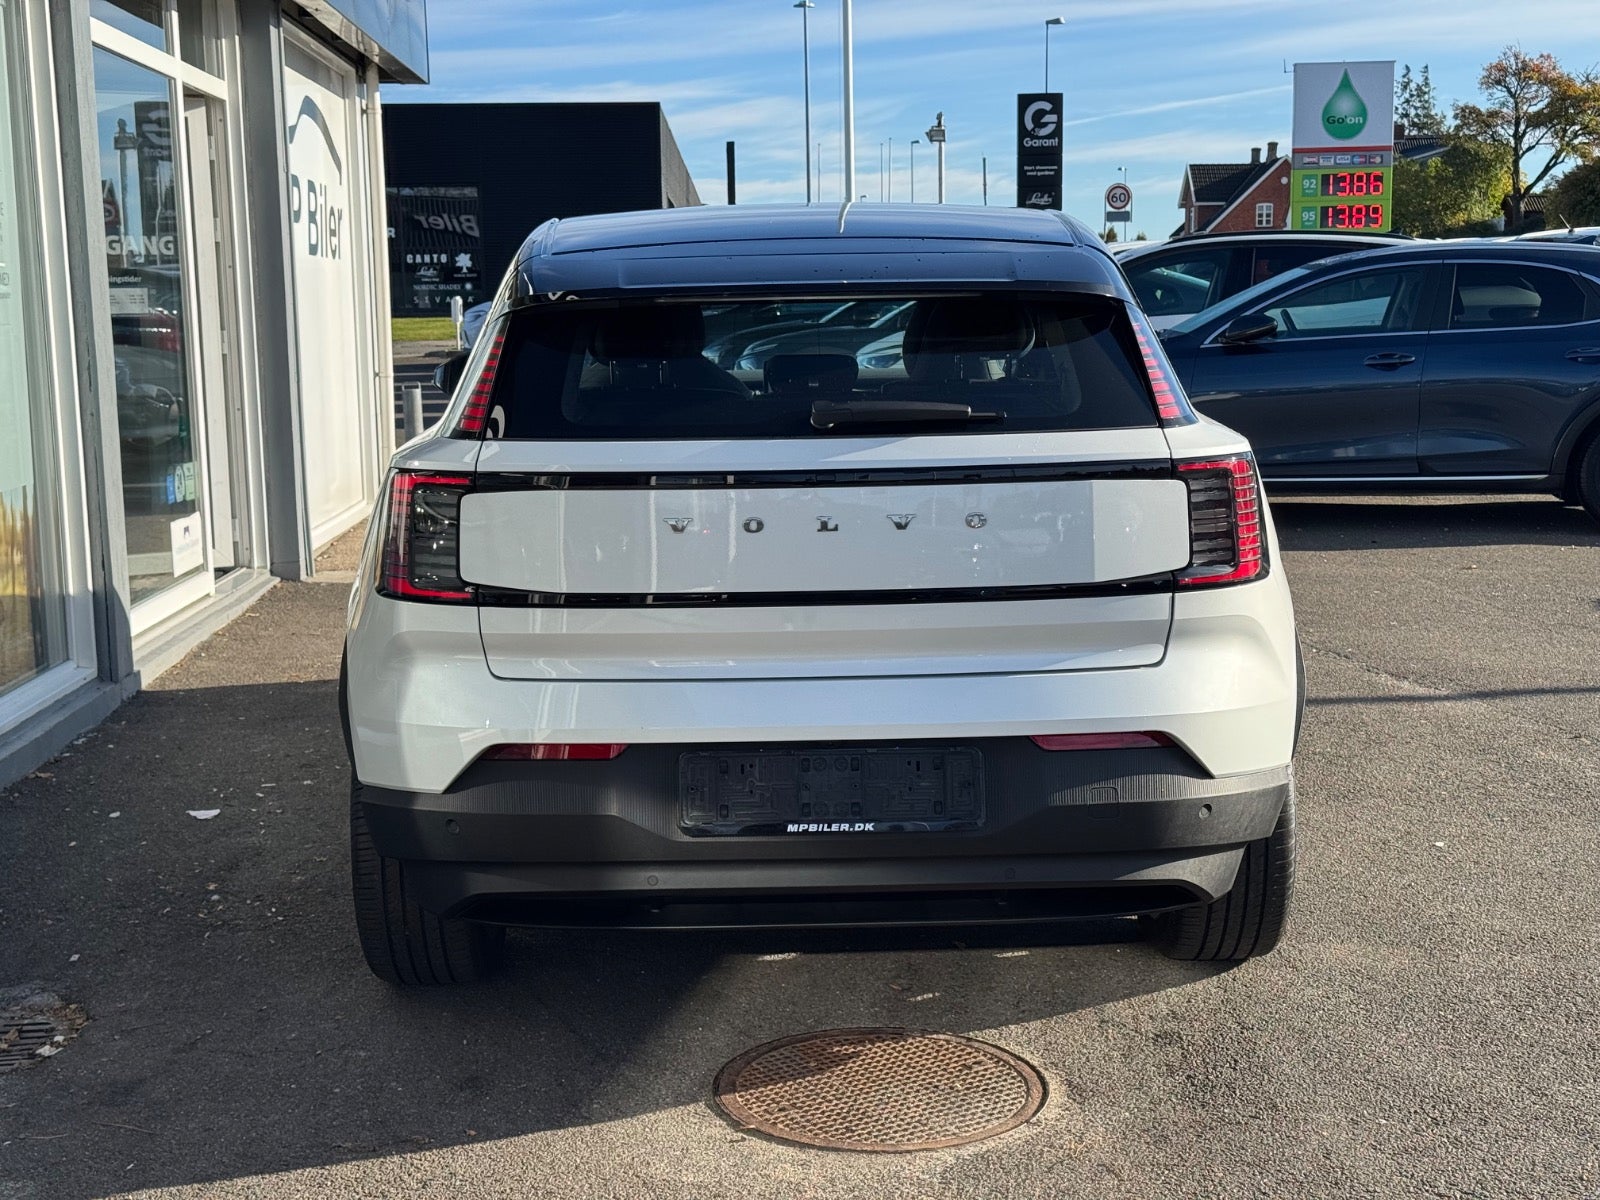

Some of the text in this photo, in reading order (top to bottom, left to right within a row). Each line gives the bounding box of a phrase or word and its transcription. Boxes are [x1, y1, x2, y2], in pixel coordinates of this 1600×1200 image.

[1023, 137, 1059, 147] Garant
[1303, 179, 1317, 189] 92
[1329, 171, 1383, 196] 13.86
[1111, 192, 1127, 204] 60
[308, 179, 343, 260] Biler
[1302, 211, 1316, 221] 95
[1328, 204, 1383, 229] 13.89
[663, 511, 987, 534] VOLVO
[786, 821, 875, 833] MPBILER.DK
